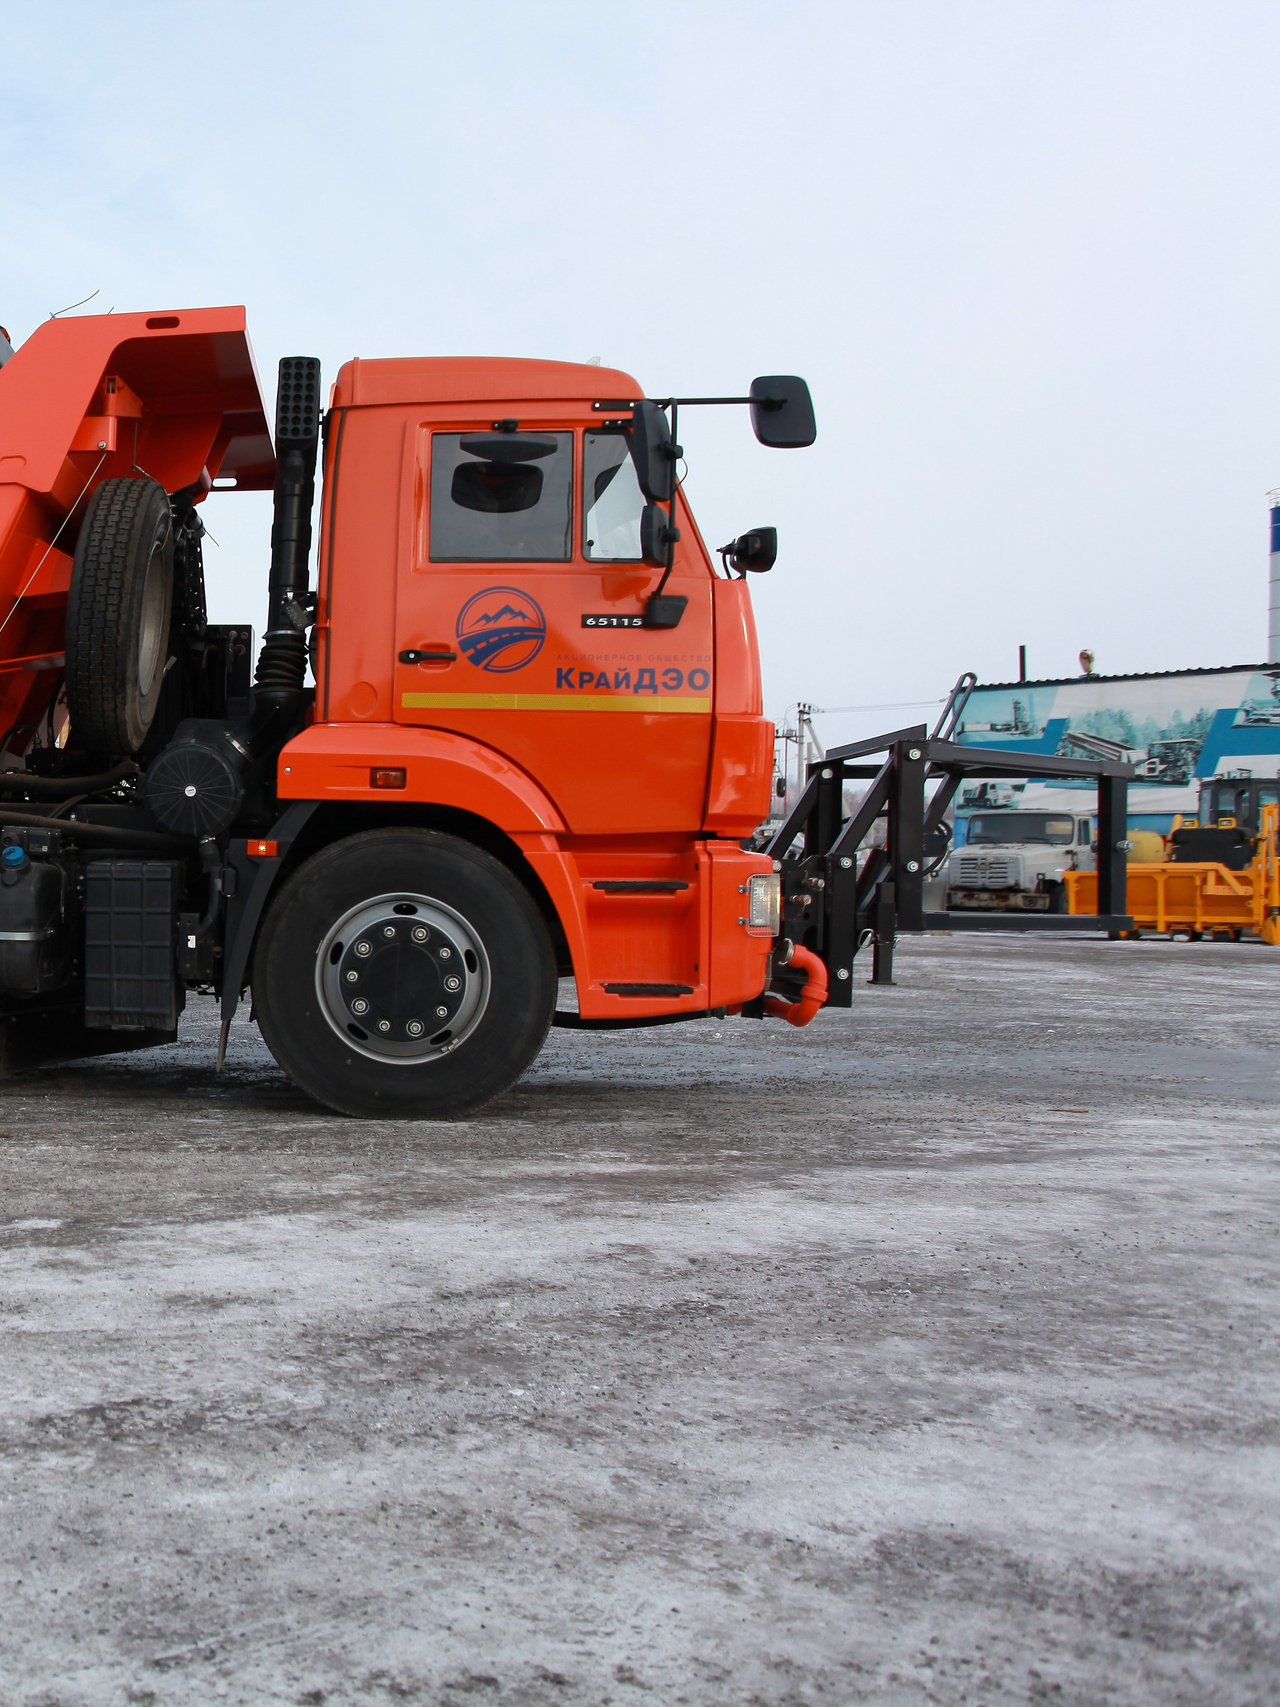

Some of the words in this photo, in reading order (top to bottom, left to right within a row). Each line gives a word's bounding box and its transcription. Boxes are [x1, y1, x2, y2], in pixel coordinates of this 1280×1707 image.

[586, 617, 642, 626] 65115
[556, 654, 642, 662] АКЦИОНЕРНОЕ
[648, 654, 711, 662] ОБЩЕСТВО
